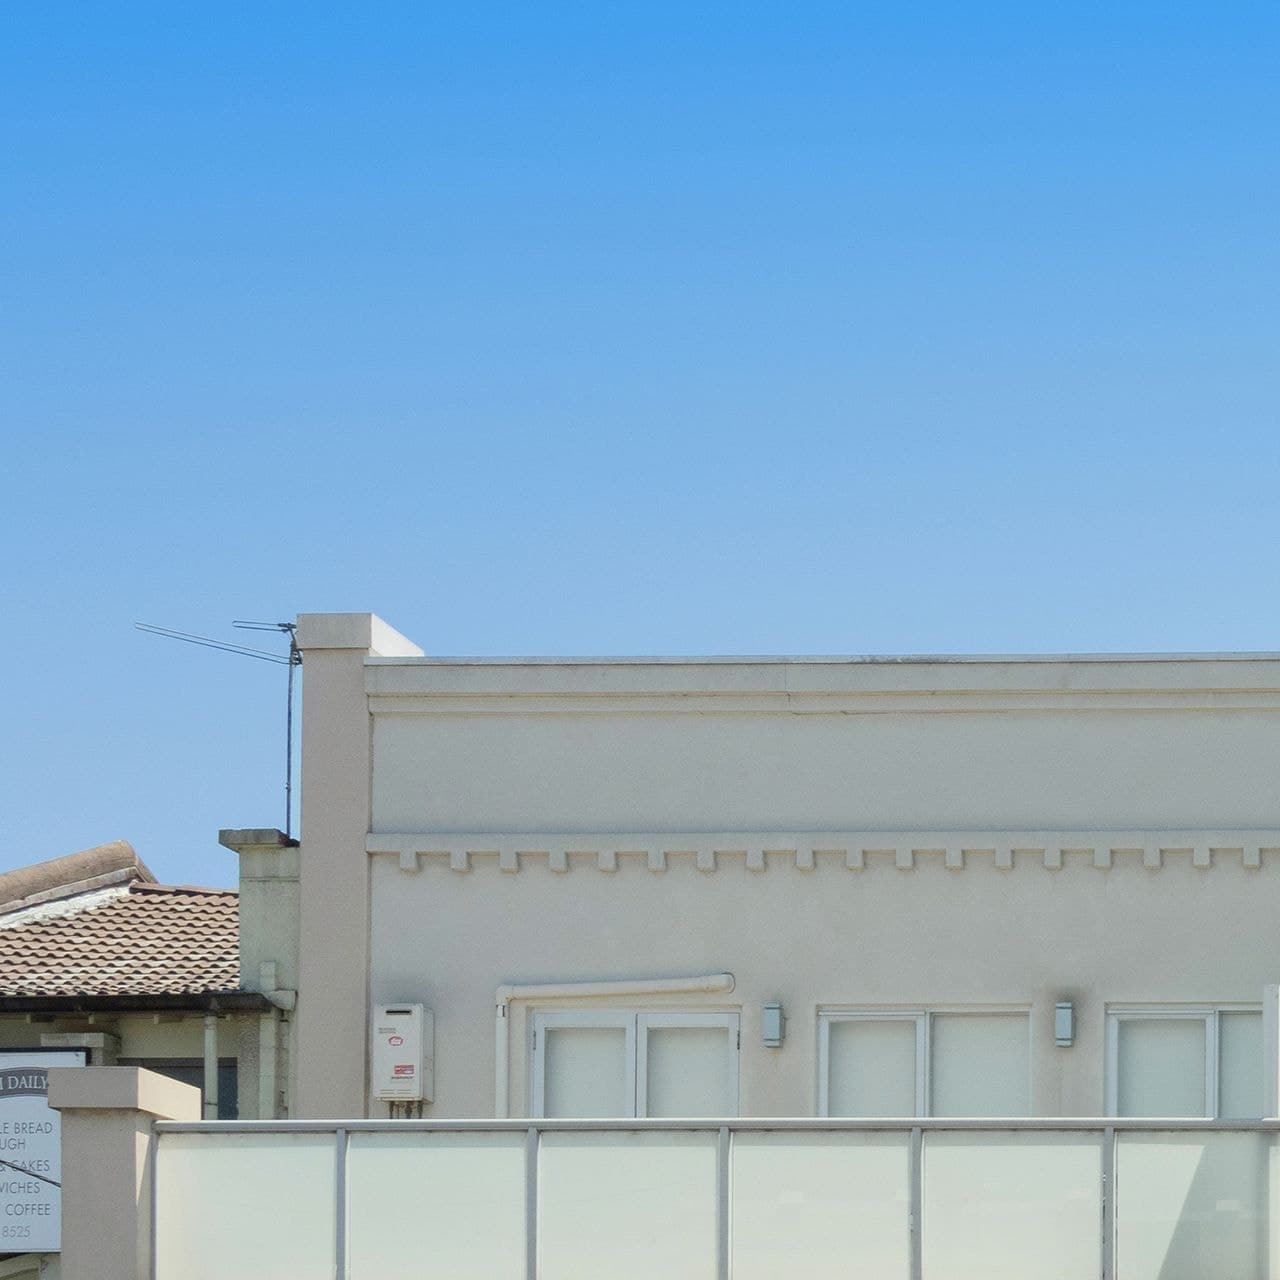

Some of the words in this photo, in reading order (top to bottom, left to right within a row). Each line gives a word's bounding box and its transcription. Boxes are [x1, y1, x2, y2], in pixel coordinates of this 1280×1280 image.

[8, 1076, 49, 1090] DAILY
[14, 1122, 53, 1135] BREAD
[5, 1203, 51, 1217] COFFEE
[2, 1225, 31, 1239] 8525
